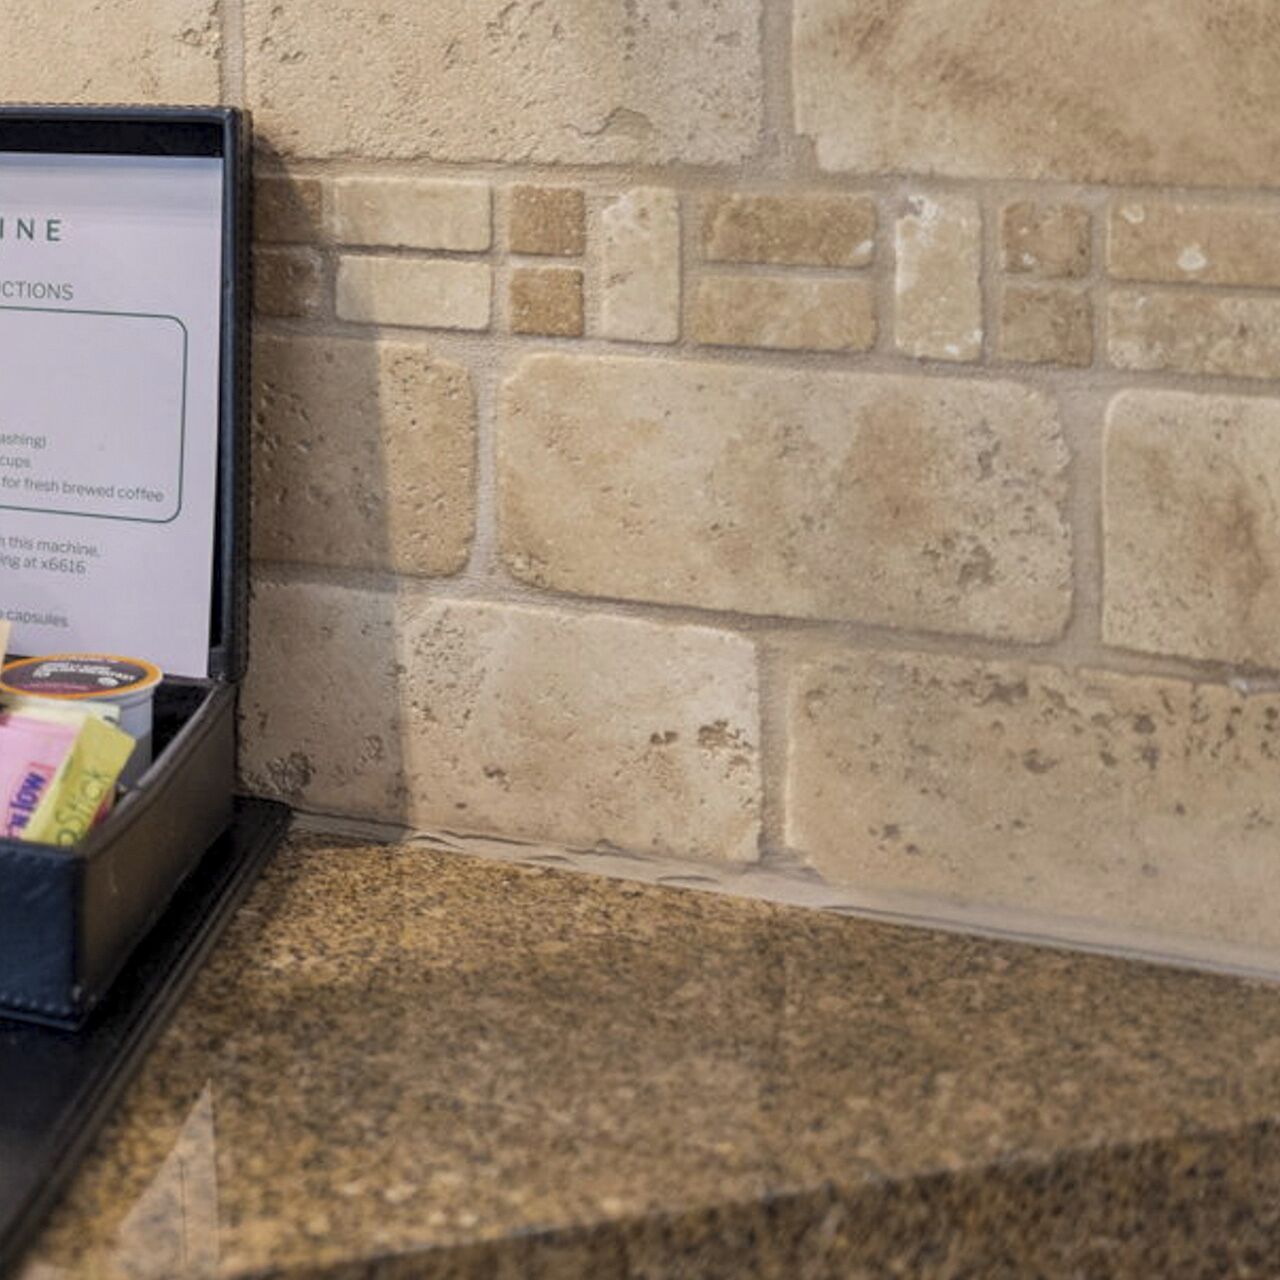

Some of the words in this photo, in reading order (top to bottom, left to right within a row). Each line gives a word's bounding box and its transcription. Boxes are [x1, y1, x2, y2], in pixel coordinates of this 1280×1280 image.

[2, 476, 21, 489] for
[24, 477, 59, 492] fresh
[62, 481, 115, 499] brewed
[117, 487, 164, 503] coffee
[8, 536, 33, 551] this
[23, 556, 37, 569] at
[40, 556, 87, 574] x6616
